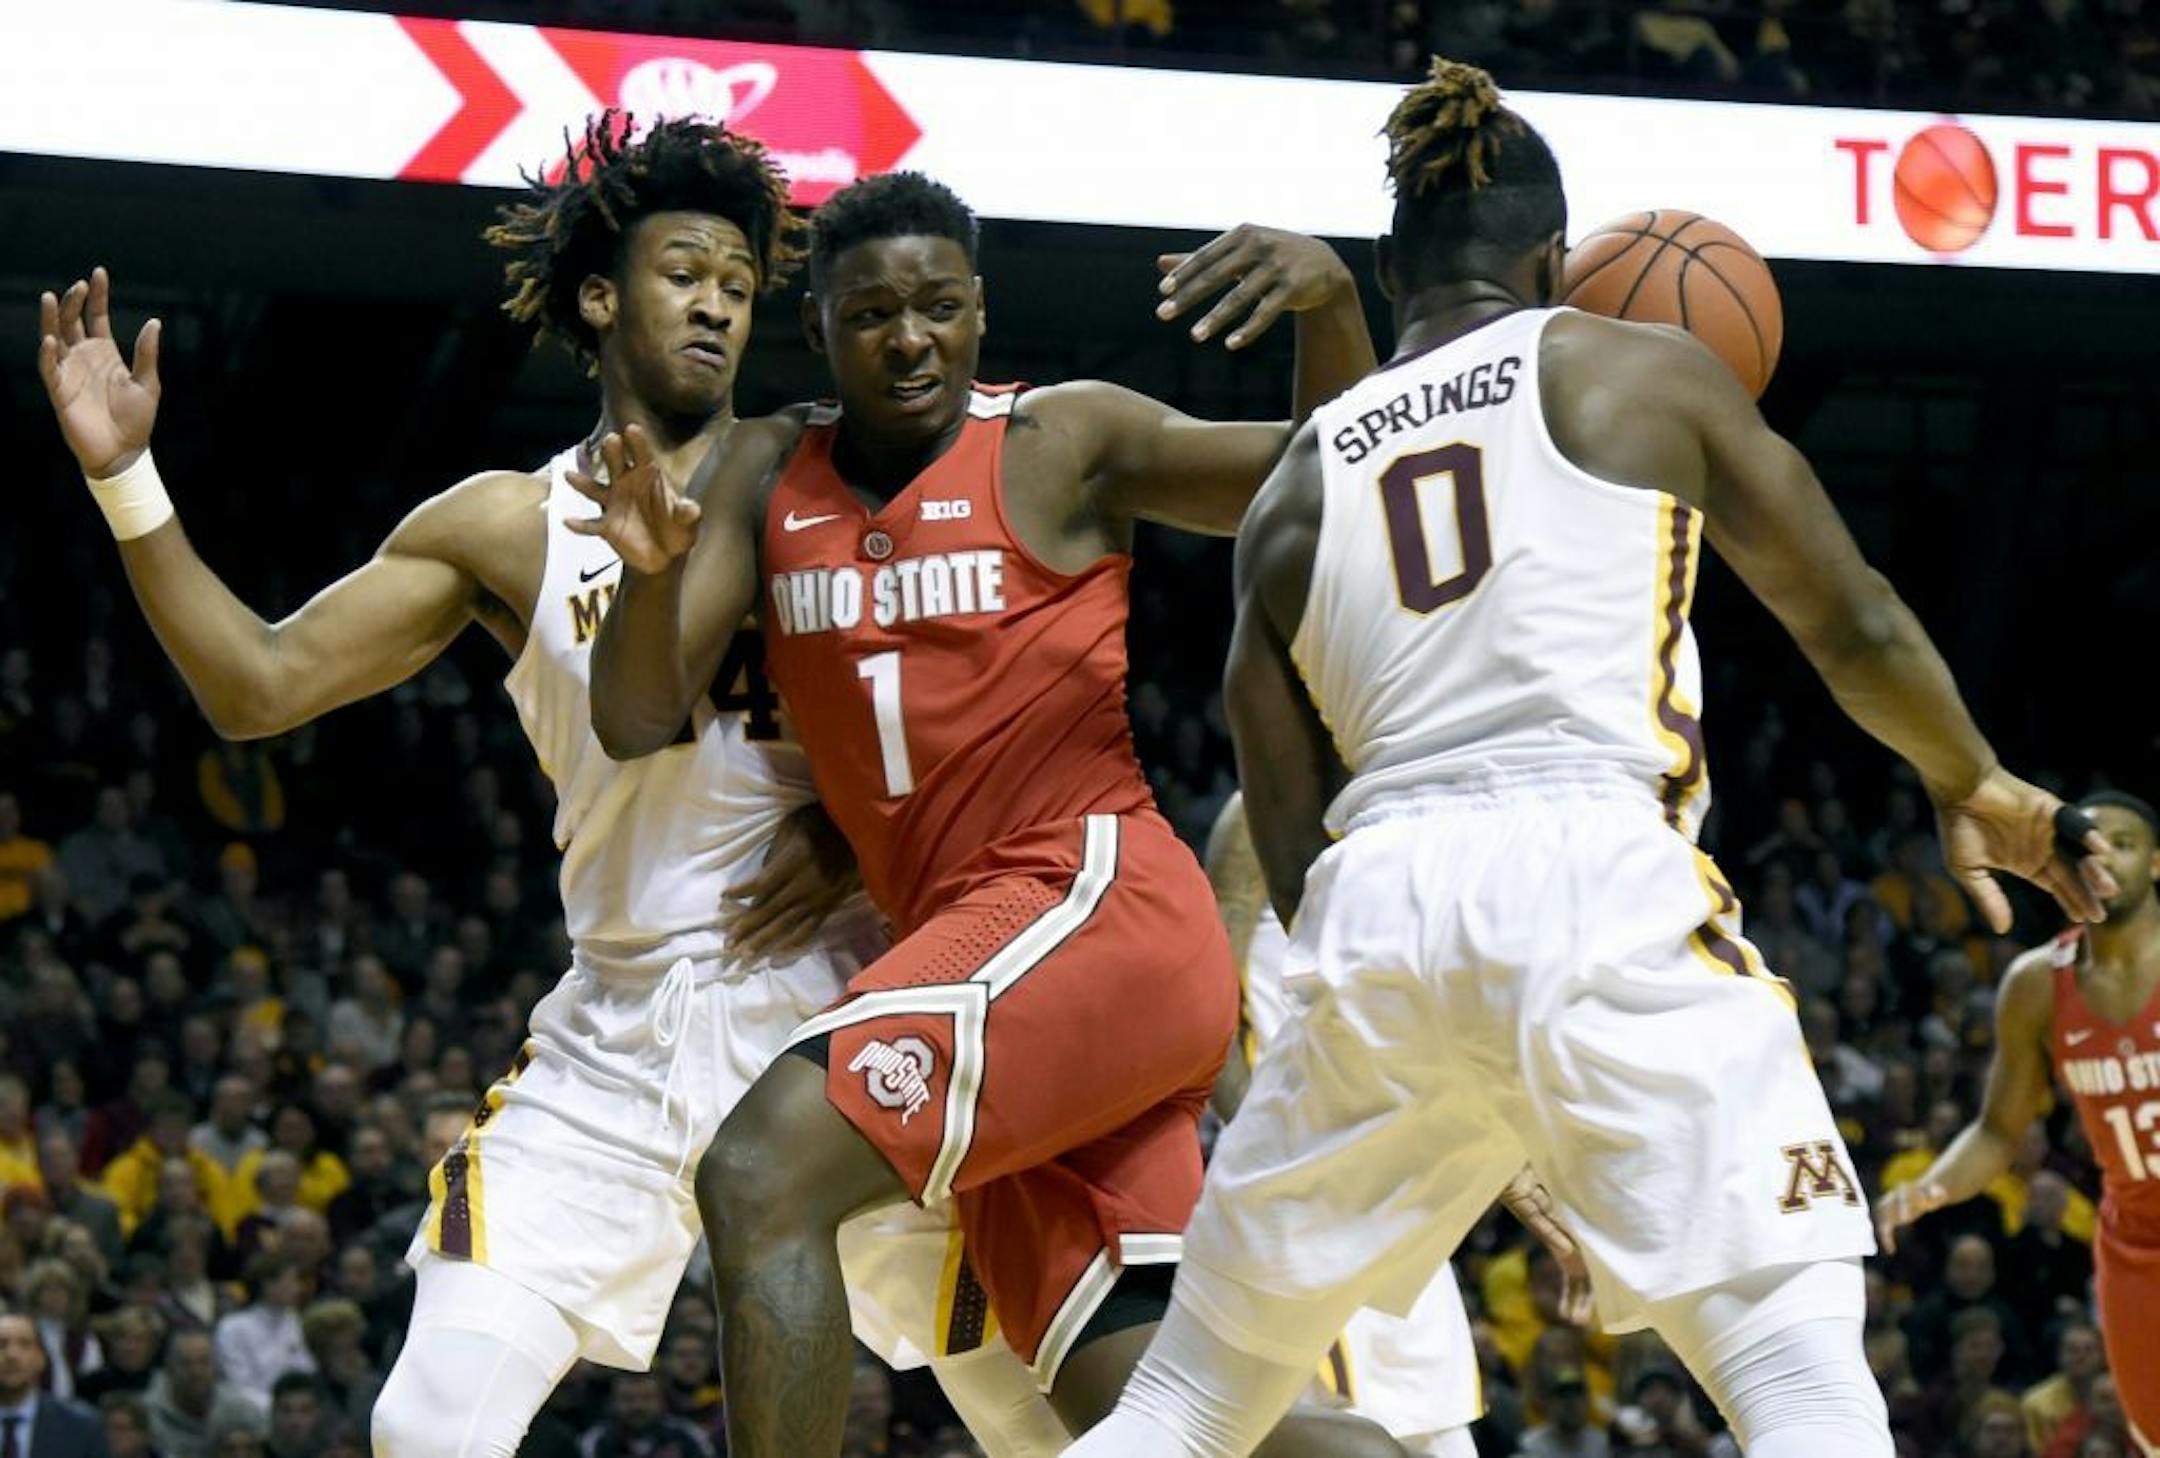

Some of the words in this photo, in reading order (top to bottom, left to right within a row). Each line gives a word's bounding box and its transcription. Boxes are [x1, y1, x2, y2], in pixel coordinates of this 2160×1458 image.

[1333, 356, 1522, 465] SPRINGS
[771, 565, 863, 636] OHIO
[871, 549, 1007, 629] STATE
[1378, 439, 1494, 619] 0
[857, 650, 914, 797] 1
